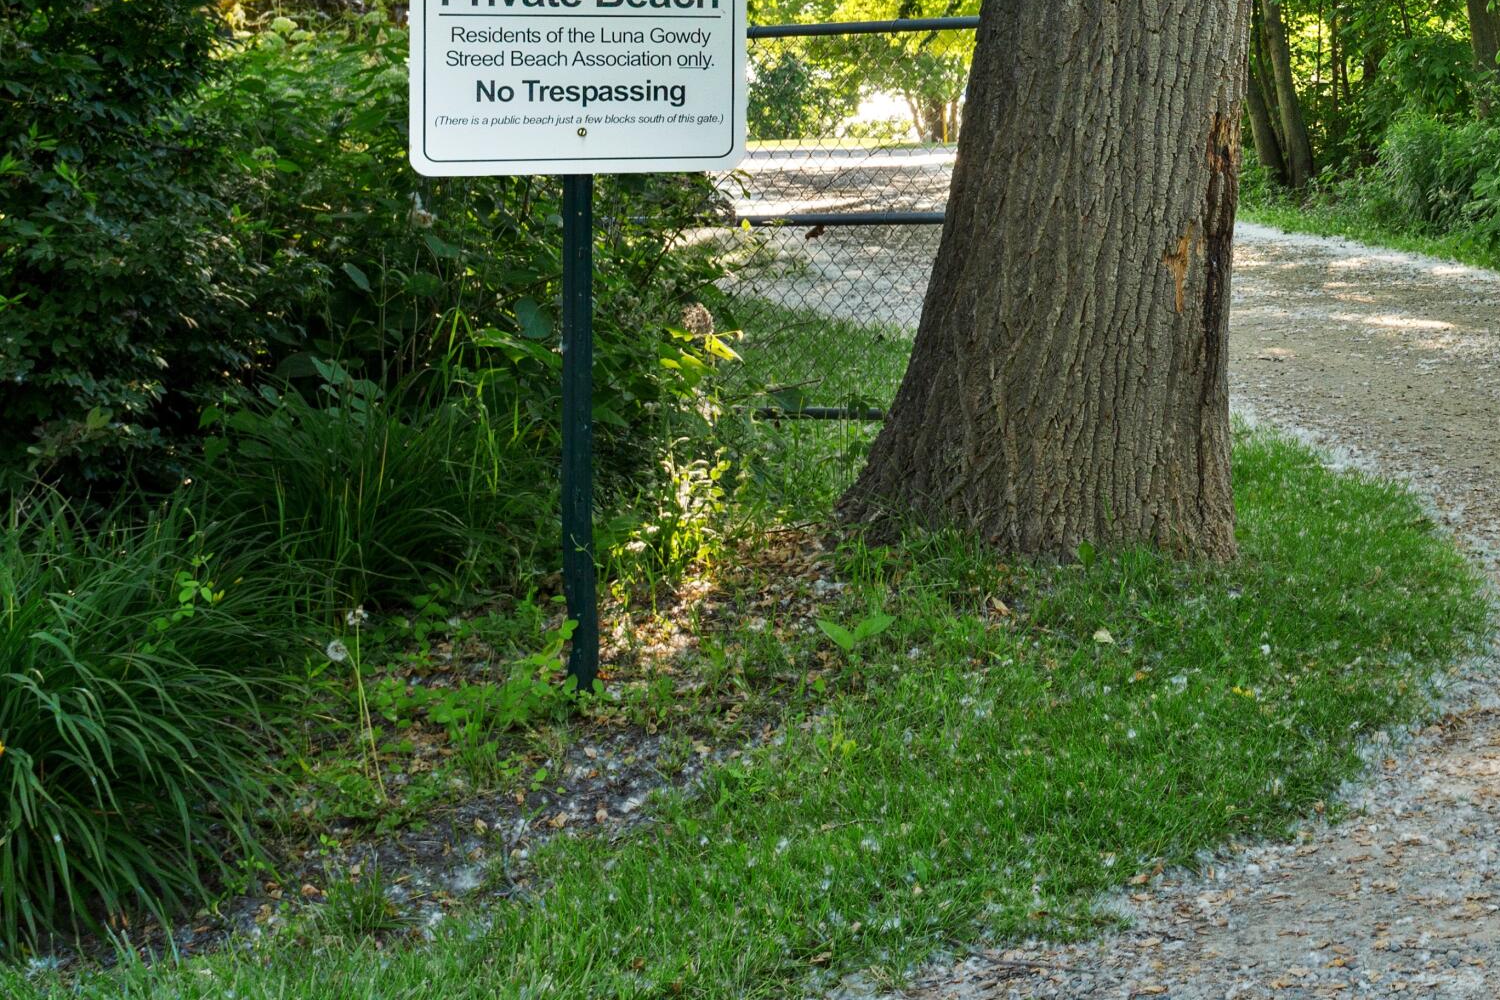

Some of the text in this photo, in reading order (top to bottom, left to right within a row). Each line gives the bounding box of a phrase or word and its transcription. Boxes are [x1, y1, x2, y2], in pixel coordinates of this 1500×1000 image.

[451, 26, 711, 47] Residents of the Luna Gowdy
[446, 51, 715, 70] Streed Beach Association only.
[476, 80, 685, 106] No Trespassing
[434, 115, 468, 127] (There
[470, 115, 480, 125] is
[490, 115, 520, 127] public
[522, 115, 554, 125] beach
[555, 115, 574, 127] just
[584, 114, 602, 124] few
[604, 114, 636, 124] blocks
[638, 114, 664, 124] south
[666, 114, 677, 124] of
[678, 114, 695, 124] this
[697, 114, 724, 126] gate.)
